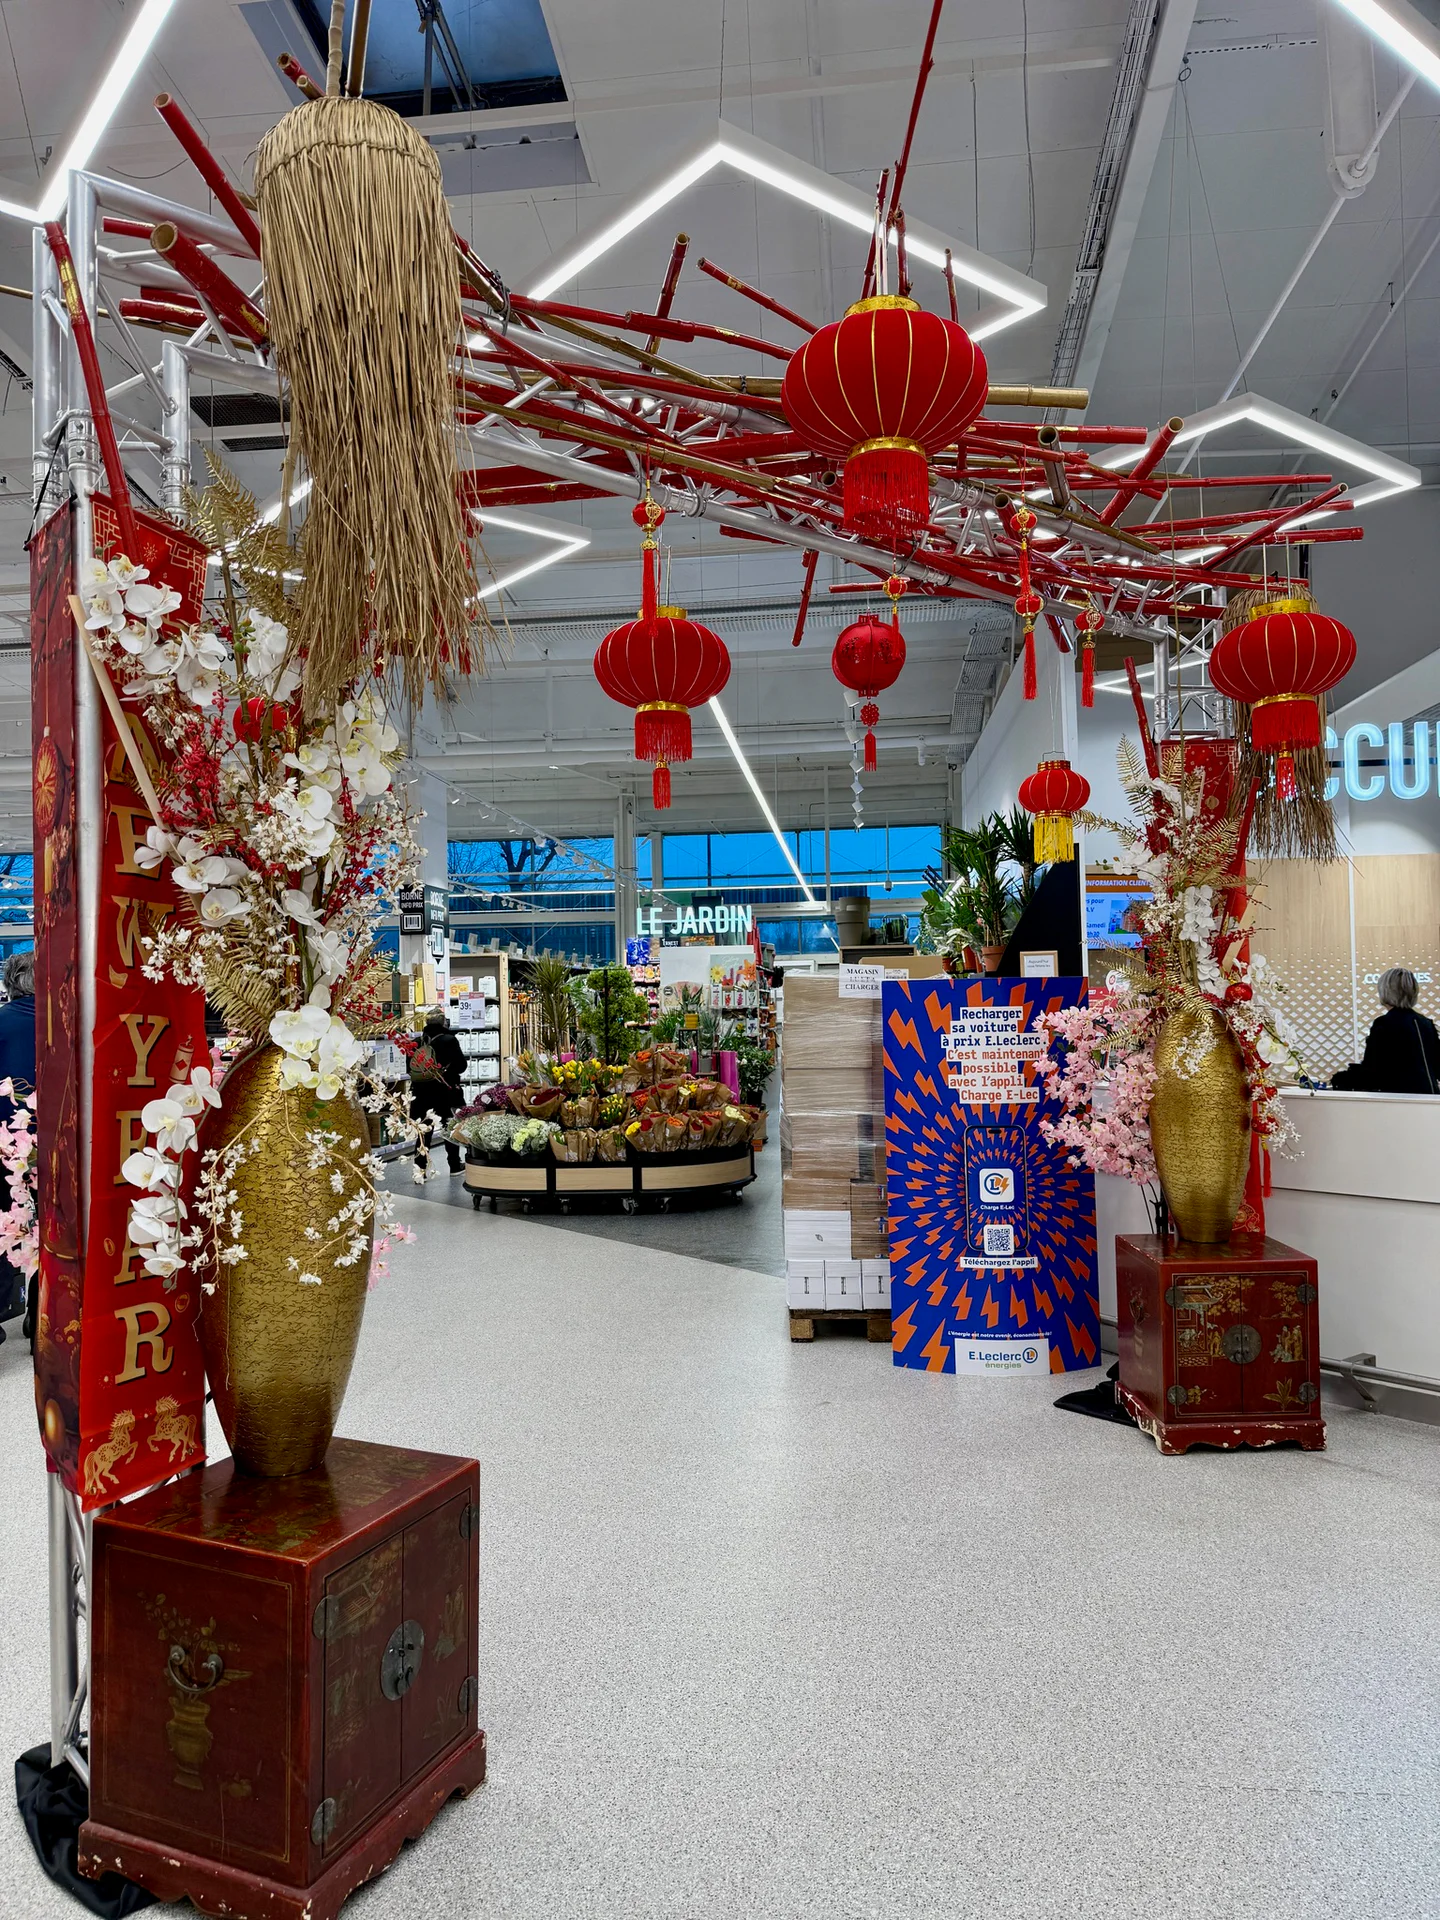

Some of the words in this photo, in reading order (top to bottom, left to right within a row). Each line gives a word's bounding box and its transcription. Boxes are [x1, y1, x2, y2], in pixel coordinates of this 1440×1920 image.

[401, 891, 424, 901] BORNE
[636, 907, 663, 935] LE
[669, 904, 753, 935] JARDIN
[845, 983, 880, 991] CHARGER
[961, 1008, 1022, 1021] Recharger
[952, 1023, 966, 1033] sa
[970, 1021, 1017, 1033] voiture
[942, 1036, 949, 1047] à
[953, 1035, 981, 1049] prix
[947, 1049, 978, 1060] C'est
[982, 1048, 1045, 1060] maintenant
[963, 1062, 1017, 1076] possible
[949, 1078, 977, 1087] avec
[982, 1075, 1024, 1089] l'appli
[961, 1089, 1002, 1103] Charge
[1006, 1089, 1038, 1100] E-Lec
[963, 1258, 1011, 1267] Téléchargez
[1012, 1257, 1035, 1267] l'appli
[968, 1350, 1022, 1361] E.Leclerc
[985, 1361, 1022, 1370] énergies
